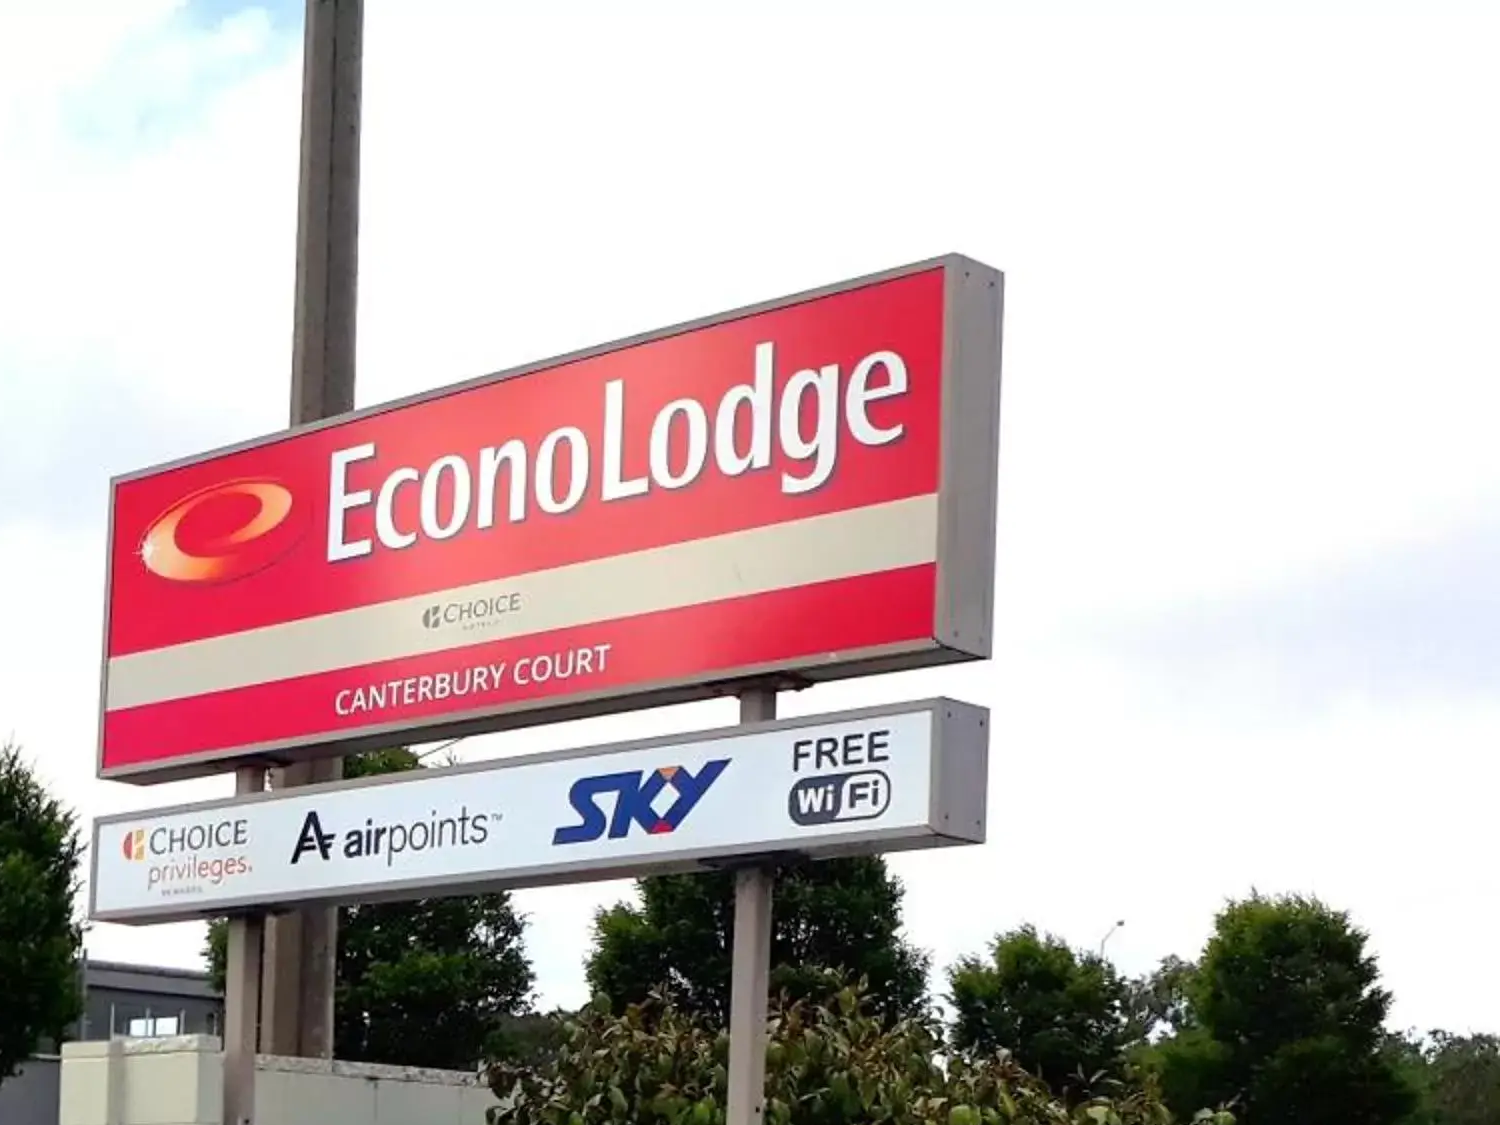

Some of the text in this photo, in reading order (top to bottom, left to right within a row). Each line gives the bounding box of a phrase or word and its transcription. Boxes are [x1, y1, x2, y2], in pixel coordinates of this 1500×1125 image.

[444, 592, 520, 623] CHOICE
[335, 643, 611, 715] CANTERBURY COURT
[793, 730, 890, 772] FREE
[552, 758, 732, 845] SKY
[149, 819, 248, 855] CHOICE
